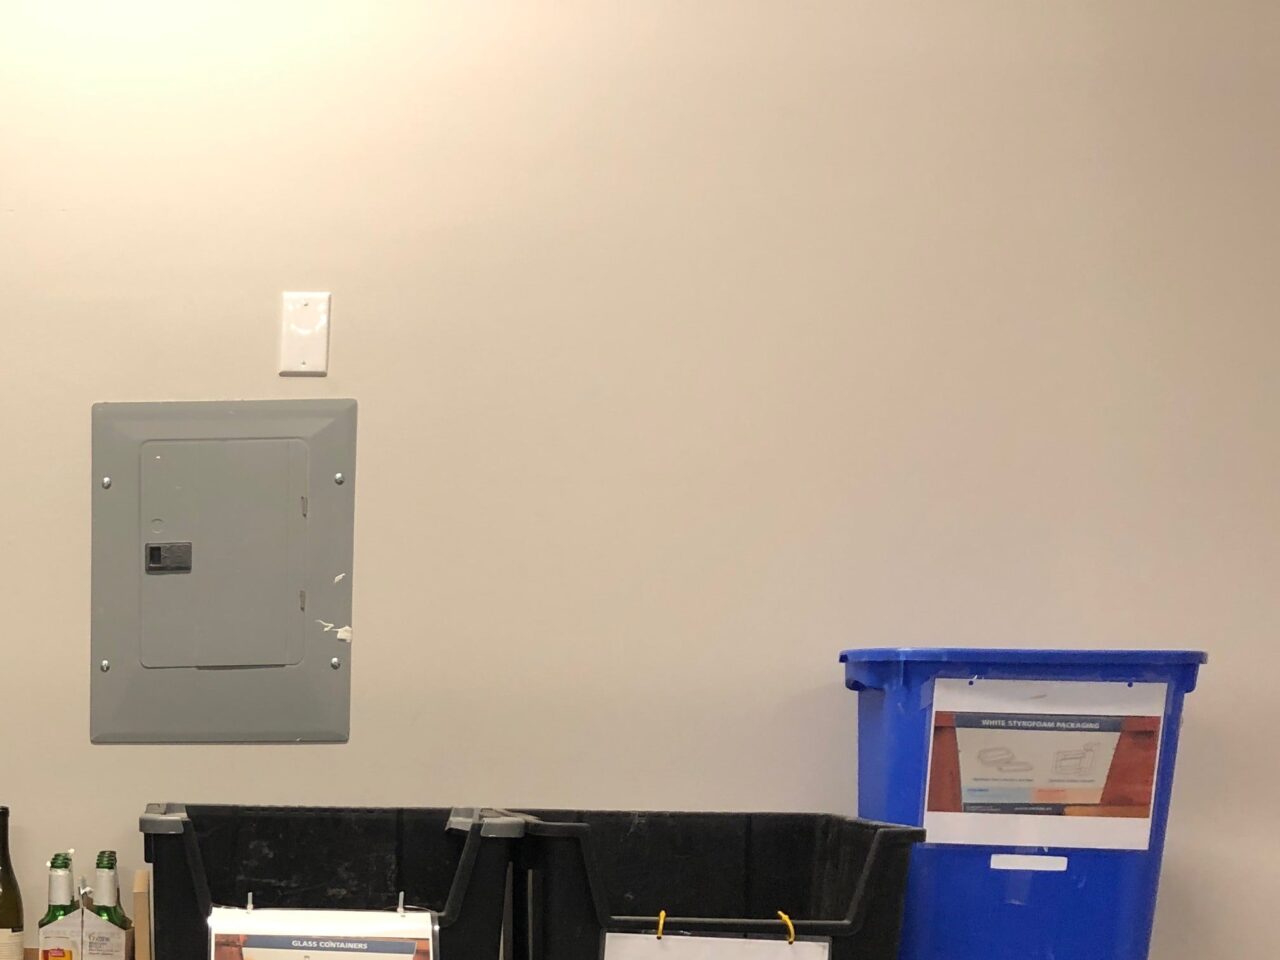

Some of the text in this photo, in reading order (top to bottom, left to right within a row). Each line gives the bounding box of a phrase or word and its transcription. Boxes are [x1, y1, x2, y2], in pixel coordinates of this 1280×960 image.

[1007, 720, 1055, 728] STYROFOAM
[291, 940, 368, 950] GLASS CONTAINERS
